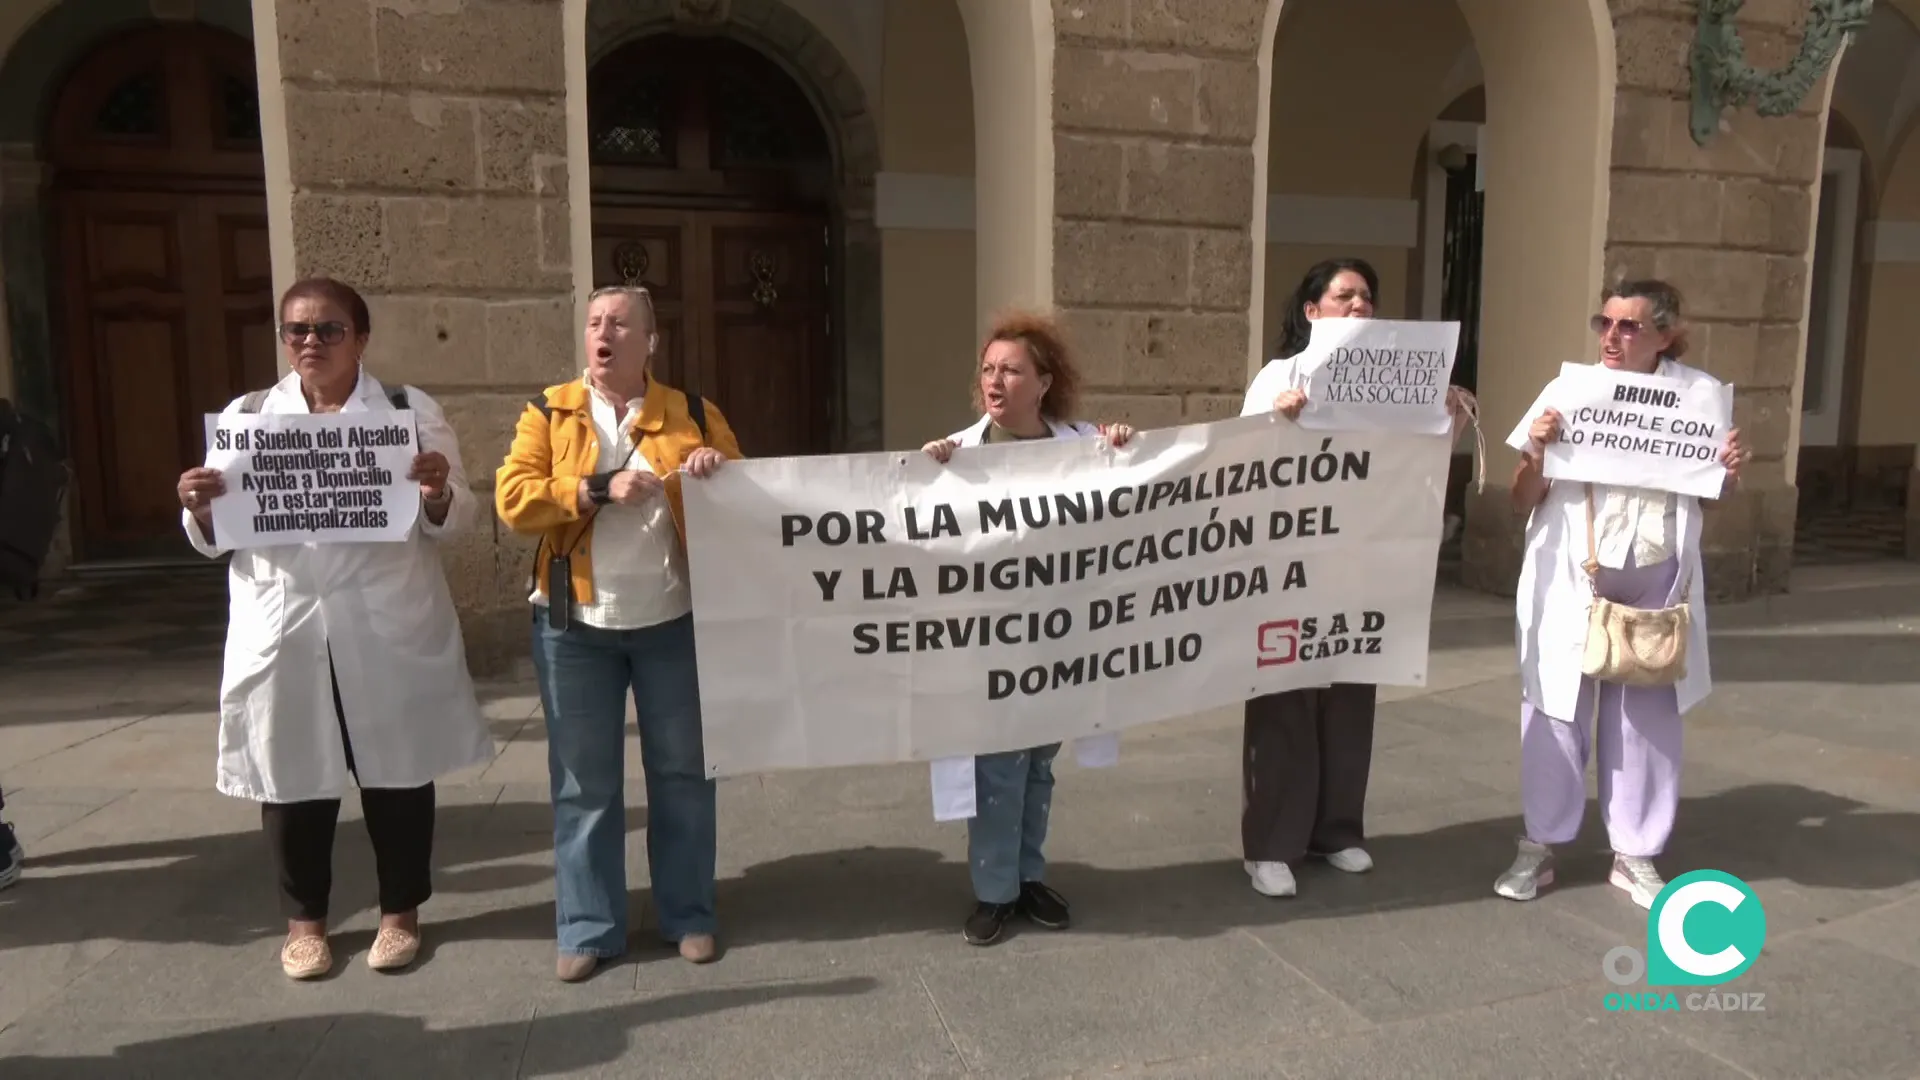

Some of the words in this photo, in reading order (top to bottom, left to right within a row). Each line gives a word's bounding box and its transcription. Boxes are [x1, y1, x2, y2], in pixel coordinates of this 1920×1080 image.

[1332, 367, 1354, 385] EL
[1356, 367, 1438, 386] ALCALDE
[1366, 384, 1438, 405] SOCIAL?
[1613, 384, 1681, 408] BRUNO:
[1572, 407, 1664, 432] ¡CUMPLE
[1670, 419, 1716, 439] CON
[215, 429, 231, 450] Si
[235, 429, 250, 450] el
[254, 428, 313, 450] Sueldo
[316, 427, 343, 448] del
[348, 425, 410, 447] Alcalde
[1559, 428, 1585, 445] LO
[1591, 432, 1717, 462] PROMETIDO!
[252, 450, 351, 473] dependiera
[355, 449, 377, 467] de
[242, 471, 298, 493] Ayuda
[301, 475, 314, 489] a
[316, 468, 393, 489] Domicilio
[781, 509, 886, 546] POR
[904, 503, 962, 540] LA
[978, 437, 1370, 534] MUNICIPALIZACIÓN
[256, 493, 279, 514] ya
[253, 508, 389, 532] municipalizadas
[813, 569, 842, 601] Y
[862, 566, 918, 600] LA
[938, 507, 1253, 595] DIGNIFICACIÓN
[1269, 505, 1340, 541] DEL
[853, 607, 1072, 655] SERVICIO
[1089, 592, 1137, 631] DE
[1150, 565, 1269, 617] AYUDA
[1282, 560, 1307, 591] A
[1299, 635, 1383, 662] CÁDIZ
[988, 632, 1202, 701] DOMICILIO
